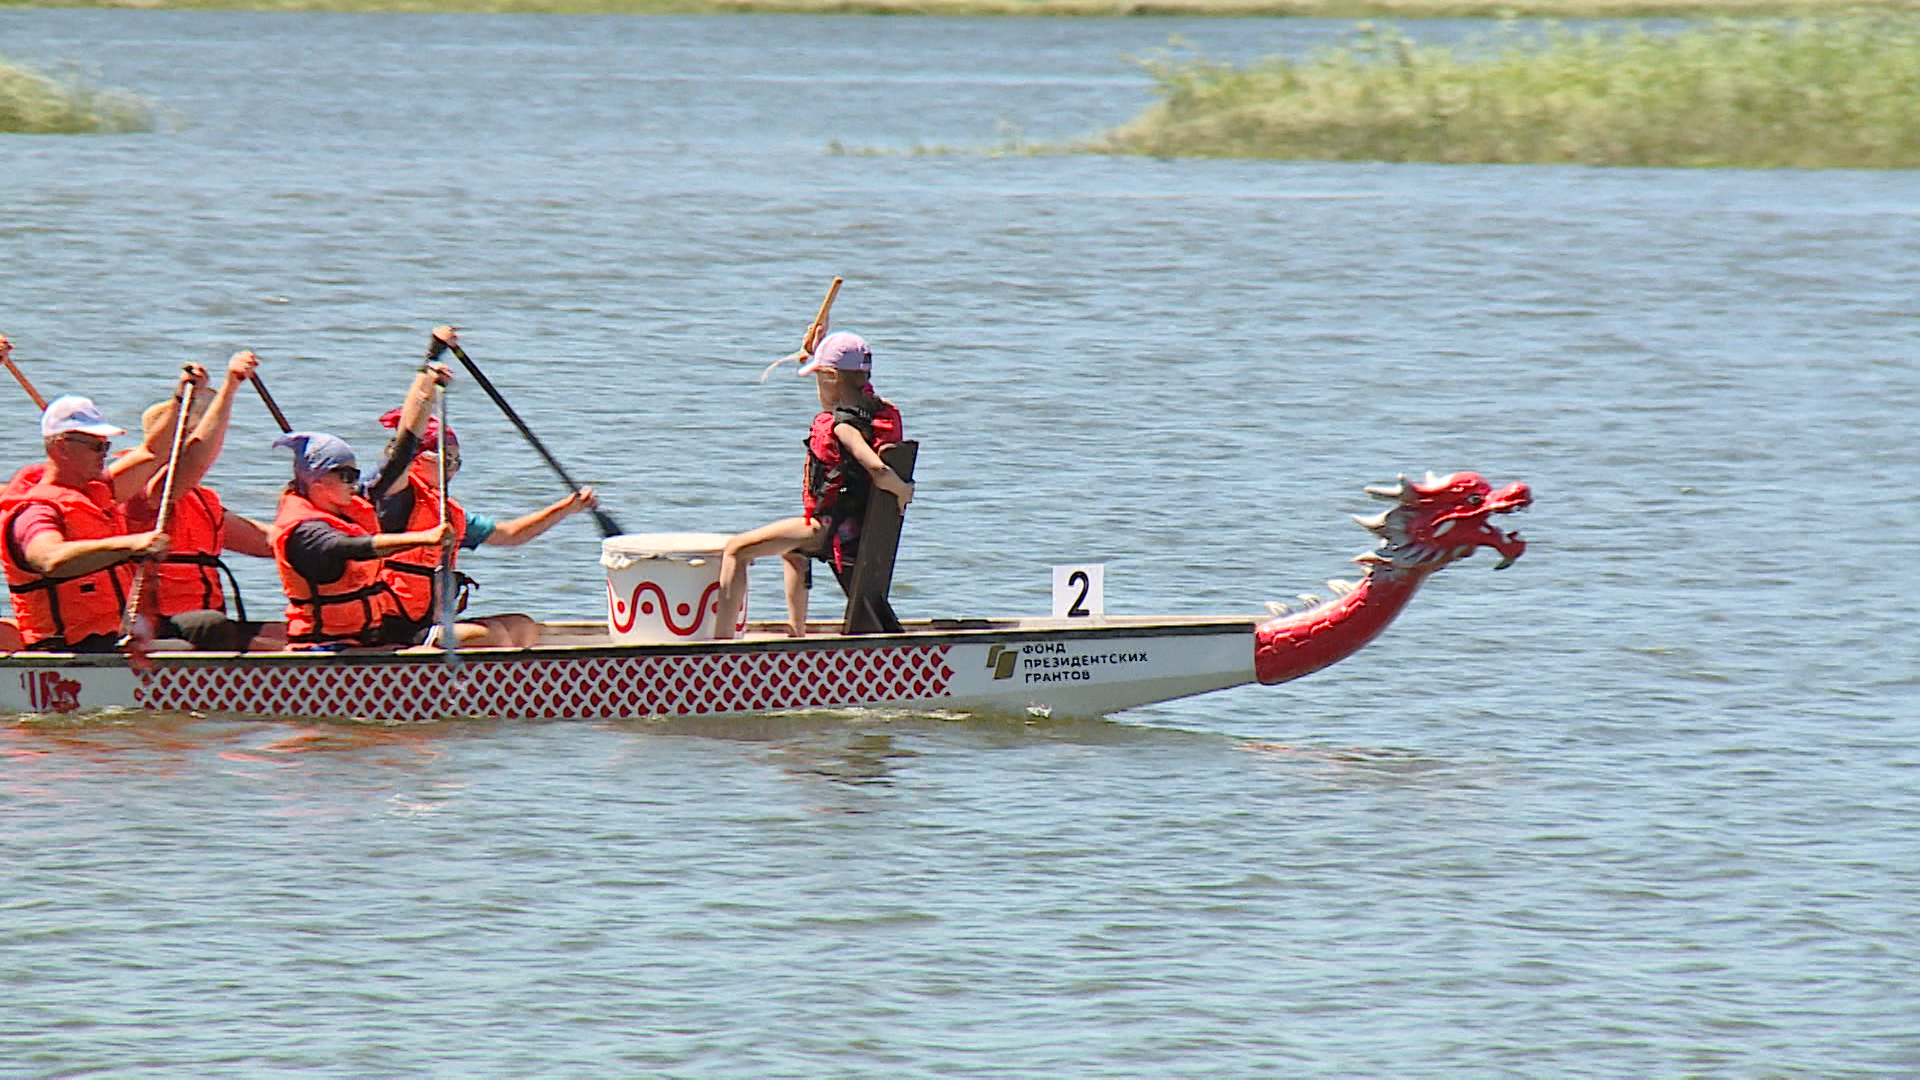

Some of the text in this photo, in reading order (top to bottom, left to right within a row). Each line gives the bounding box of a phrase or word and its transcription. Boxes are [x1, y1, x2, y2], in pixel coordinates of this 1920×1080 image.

[1067, 570, 1090, 618] 2
[1022, 643, 1067, 654] ФОНД
[1023, 652, 1149, 669] ПРЕЗИДЕНТСКИХ
[1025, 671, 1091, 684] ГРАНТОВ
